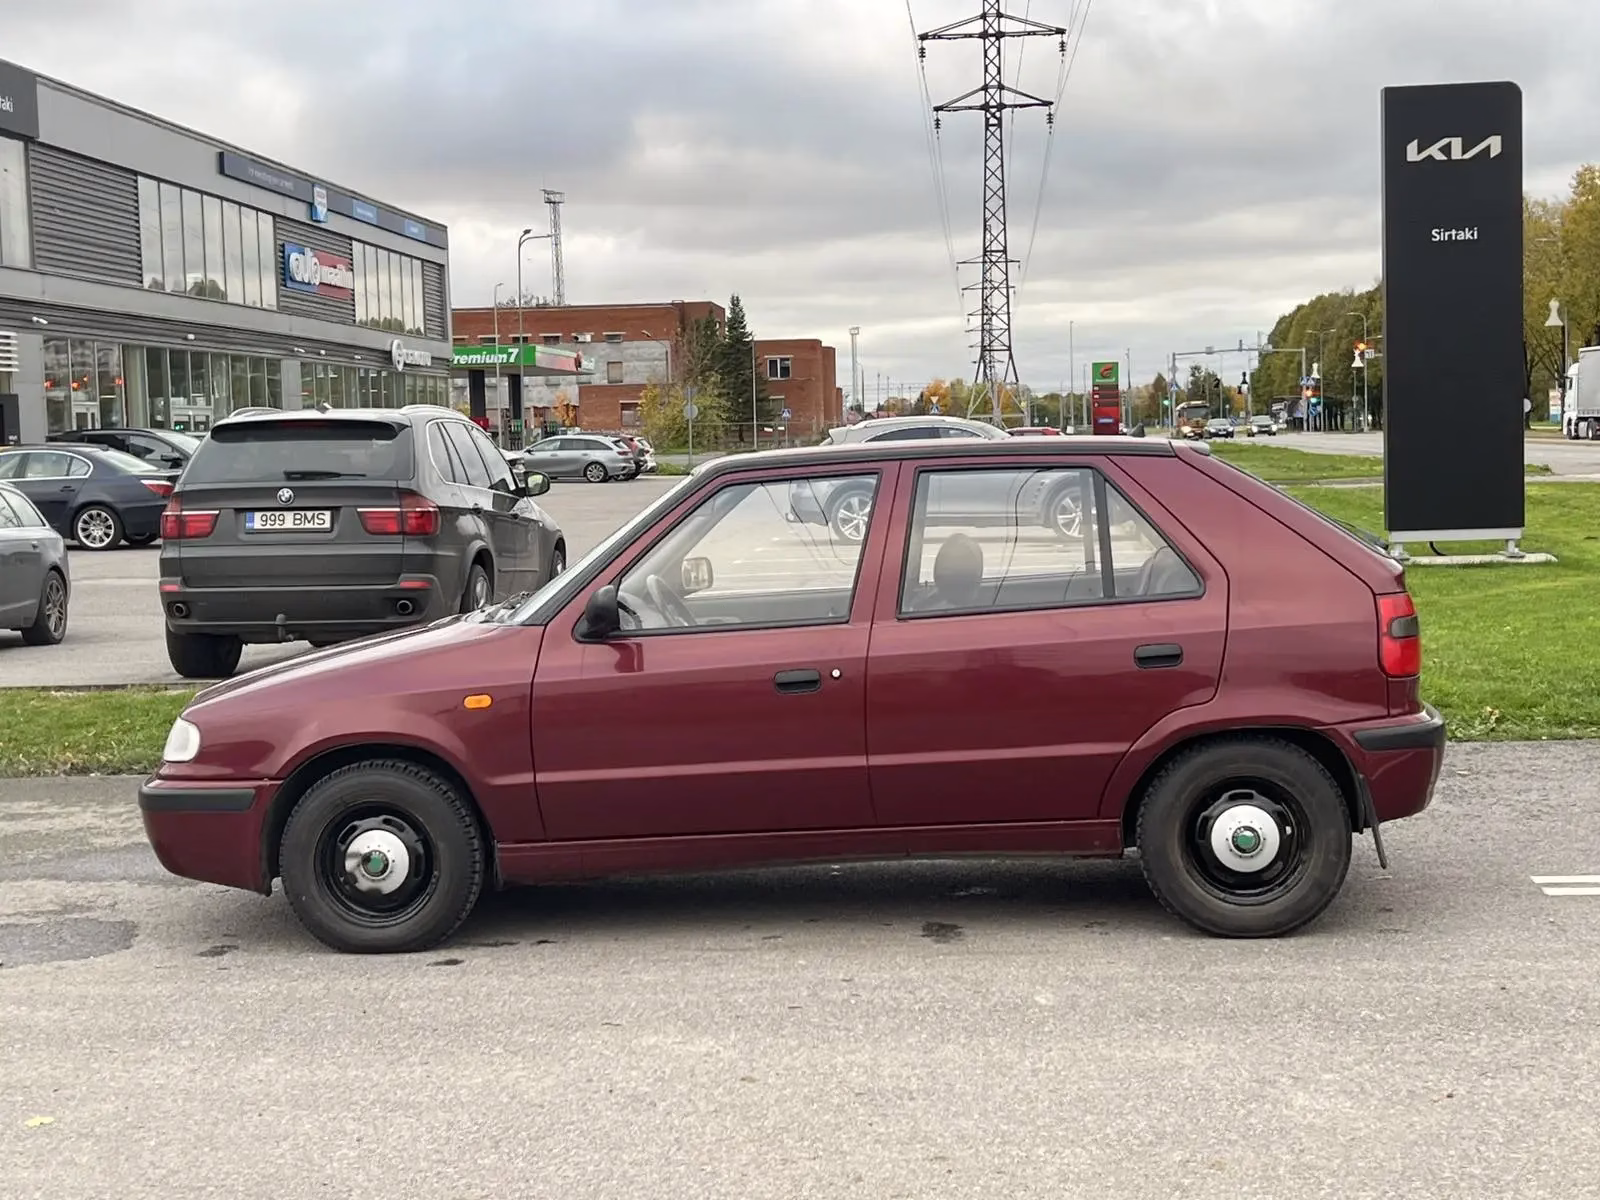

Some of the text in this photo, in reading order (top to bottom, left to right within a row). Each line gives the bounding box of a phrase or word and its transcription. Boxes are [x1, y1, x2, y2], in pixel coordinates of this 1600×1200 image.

[1406, 135, 1502, 162] KIA
[1431, 227, 1478, 242] Sirtaki
[260, 512, 326, 527] 999 BMS
